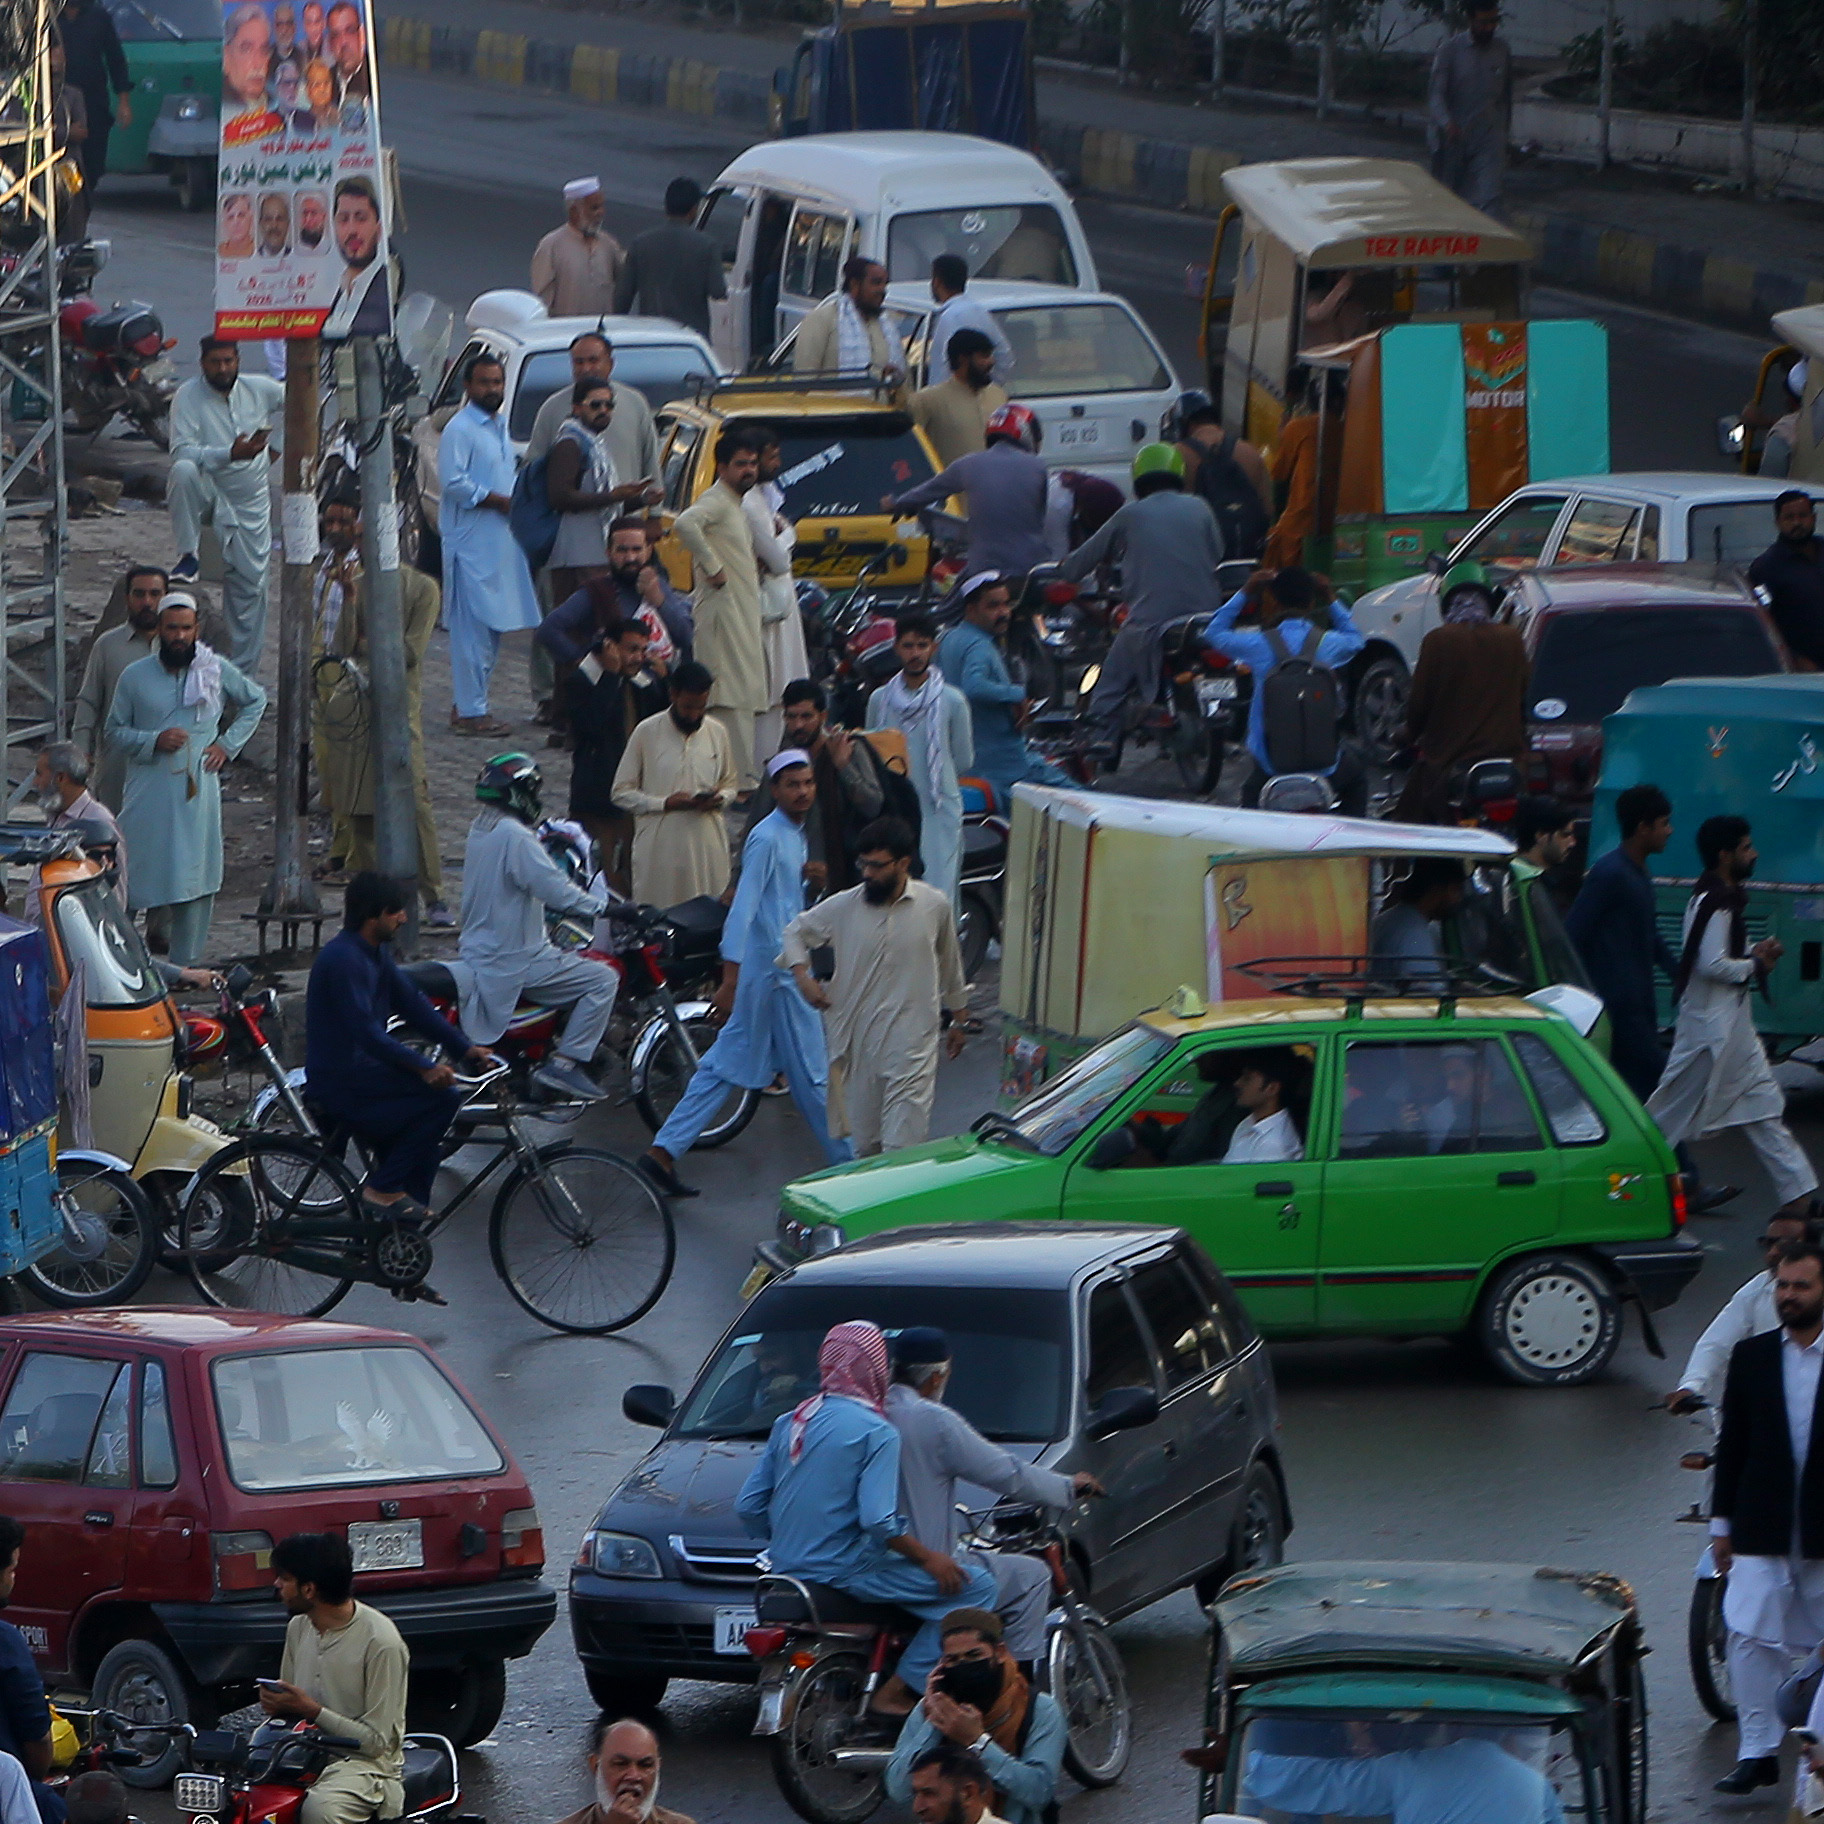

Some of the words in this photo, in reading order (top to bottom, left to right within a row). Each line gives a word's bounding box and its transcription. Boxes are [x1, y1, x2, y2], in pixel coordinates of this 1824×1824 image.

[1364, 236, 1401, 257] TEZ
[1403, 233, 1482, 257] RAFTAR
[1464, 390, 1524, 409] MOTOR
